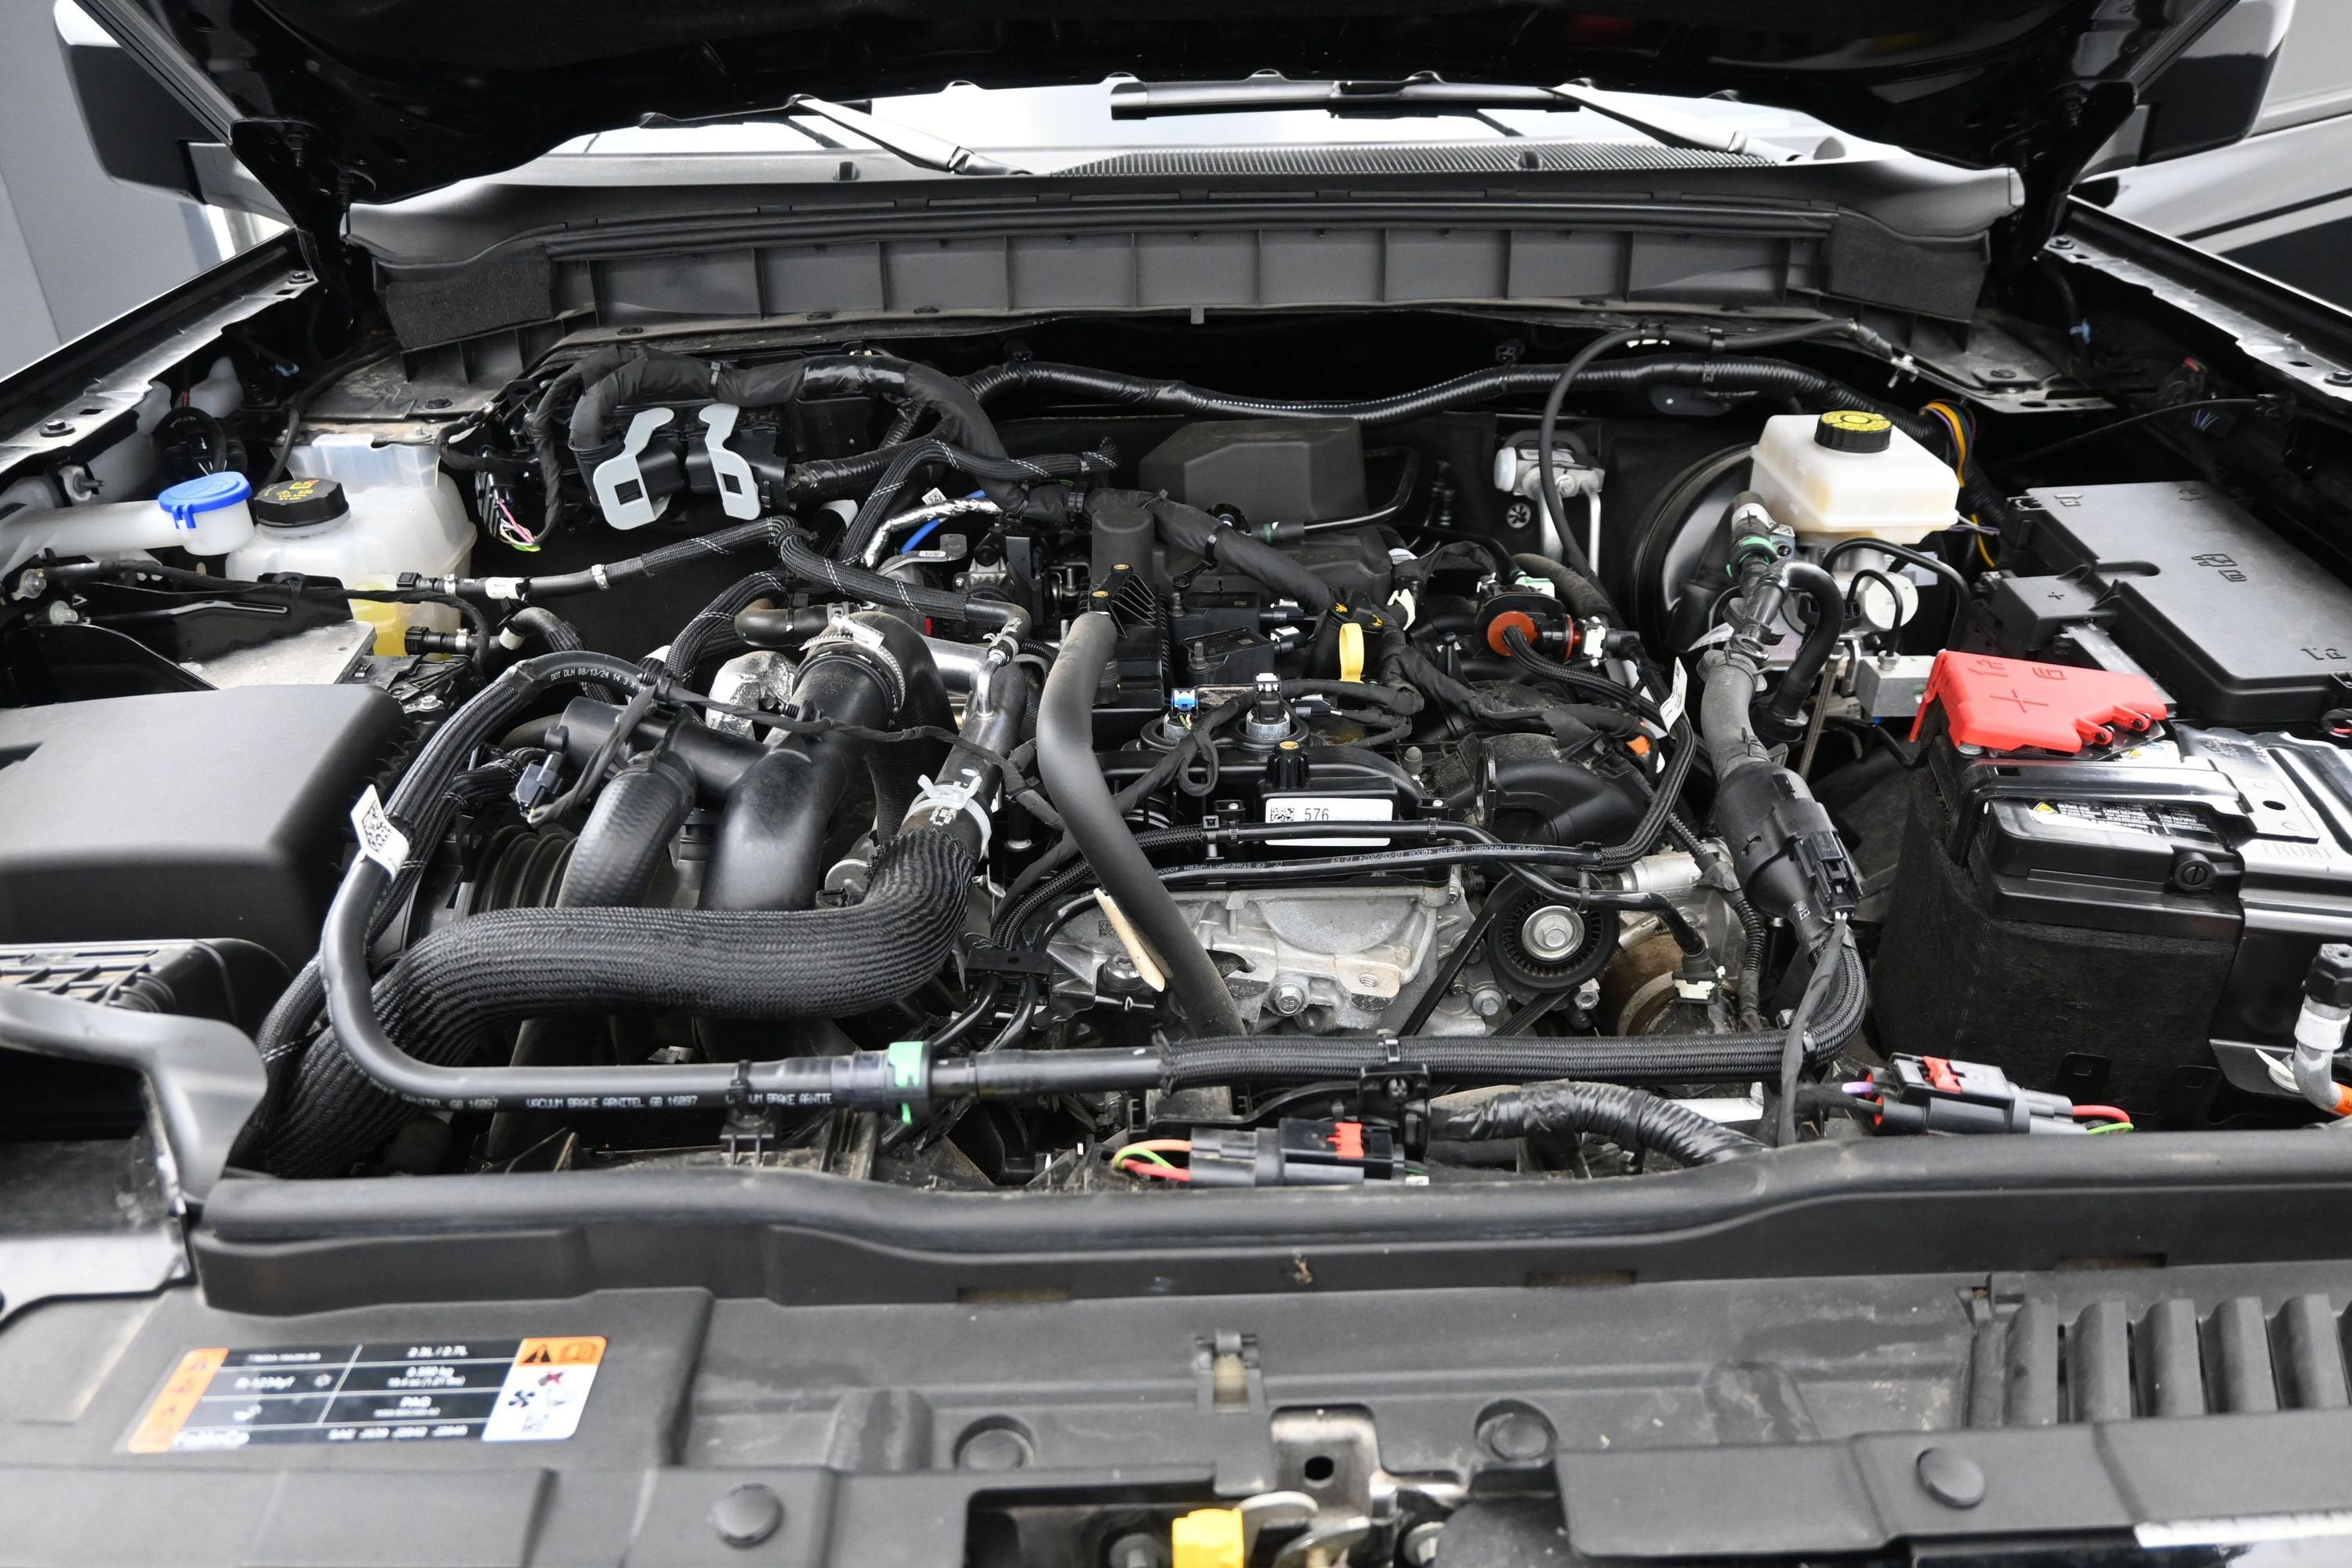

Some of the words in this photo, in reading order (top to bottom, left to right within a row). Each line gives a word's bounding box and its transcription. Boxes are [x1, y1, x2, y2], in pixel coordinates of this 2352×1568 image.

[550, 670, 561, 681] DOT
[578, 667, 610, 679] 08/13/24
[612, 673, 629, 685] 14.3
[1305, 808, 1330, 822] 576
[2261, 841, 2332, 860] FRONT
[526, 1098, 563, 1109] VACUUM
[567, 1098, 598, 1109] BRAKE
[766, 1093, 796, 1105] BRAKE
